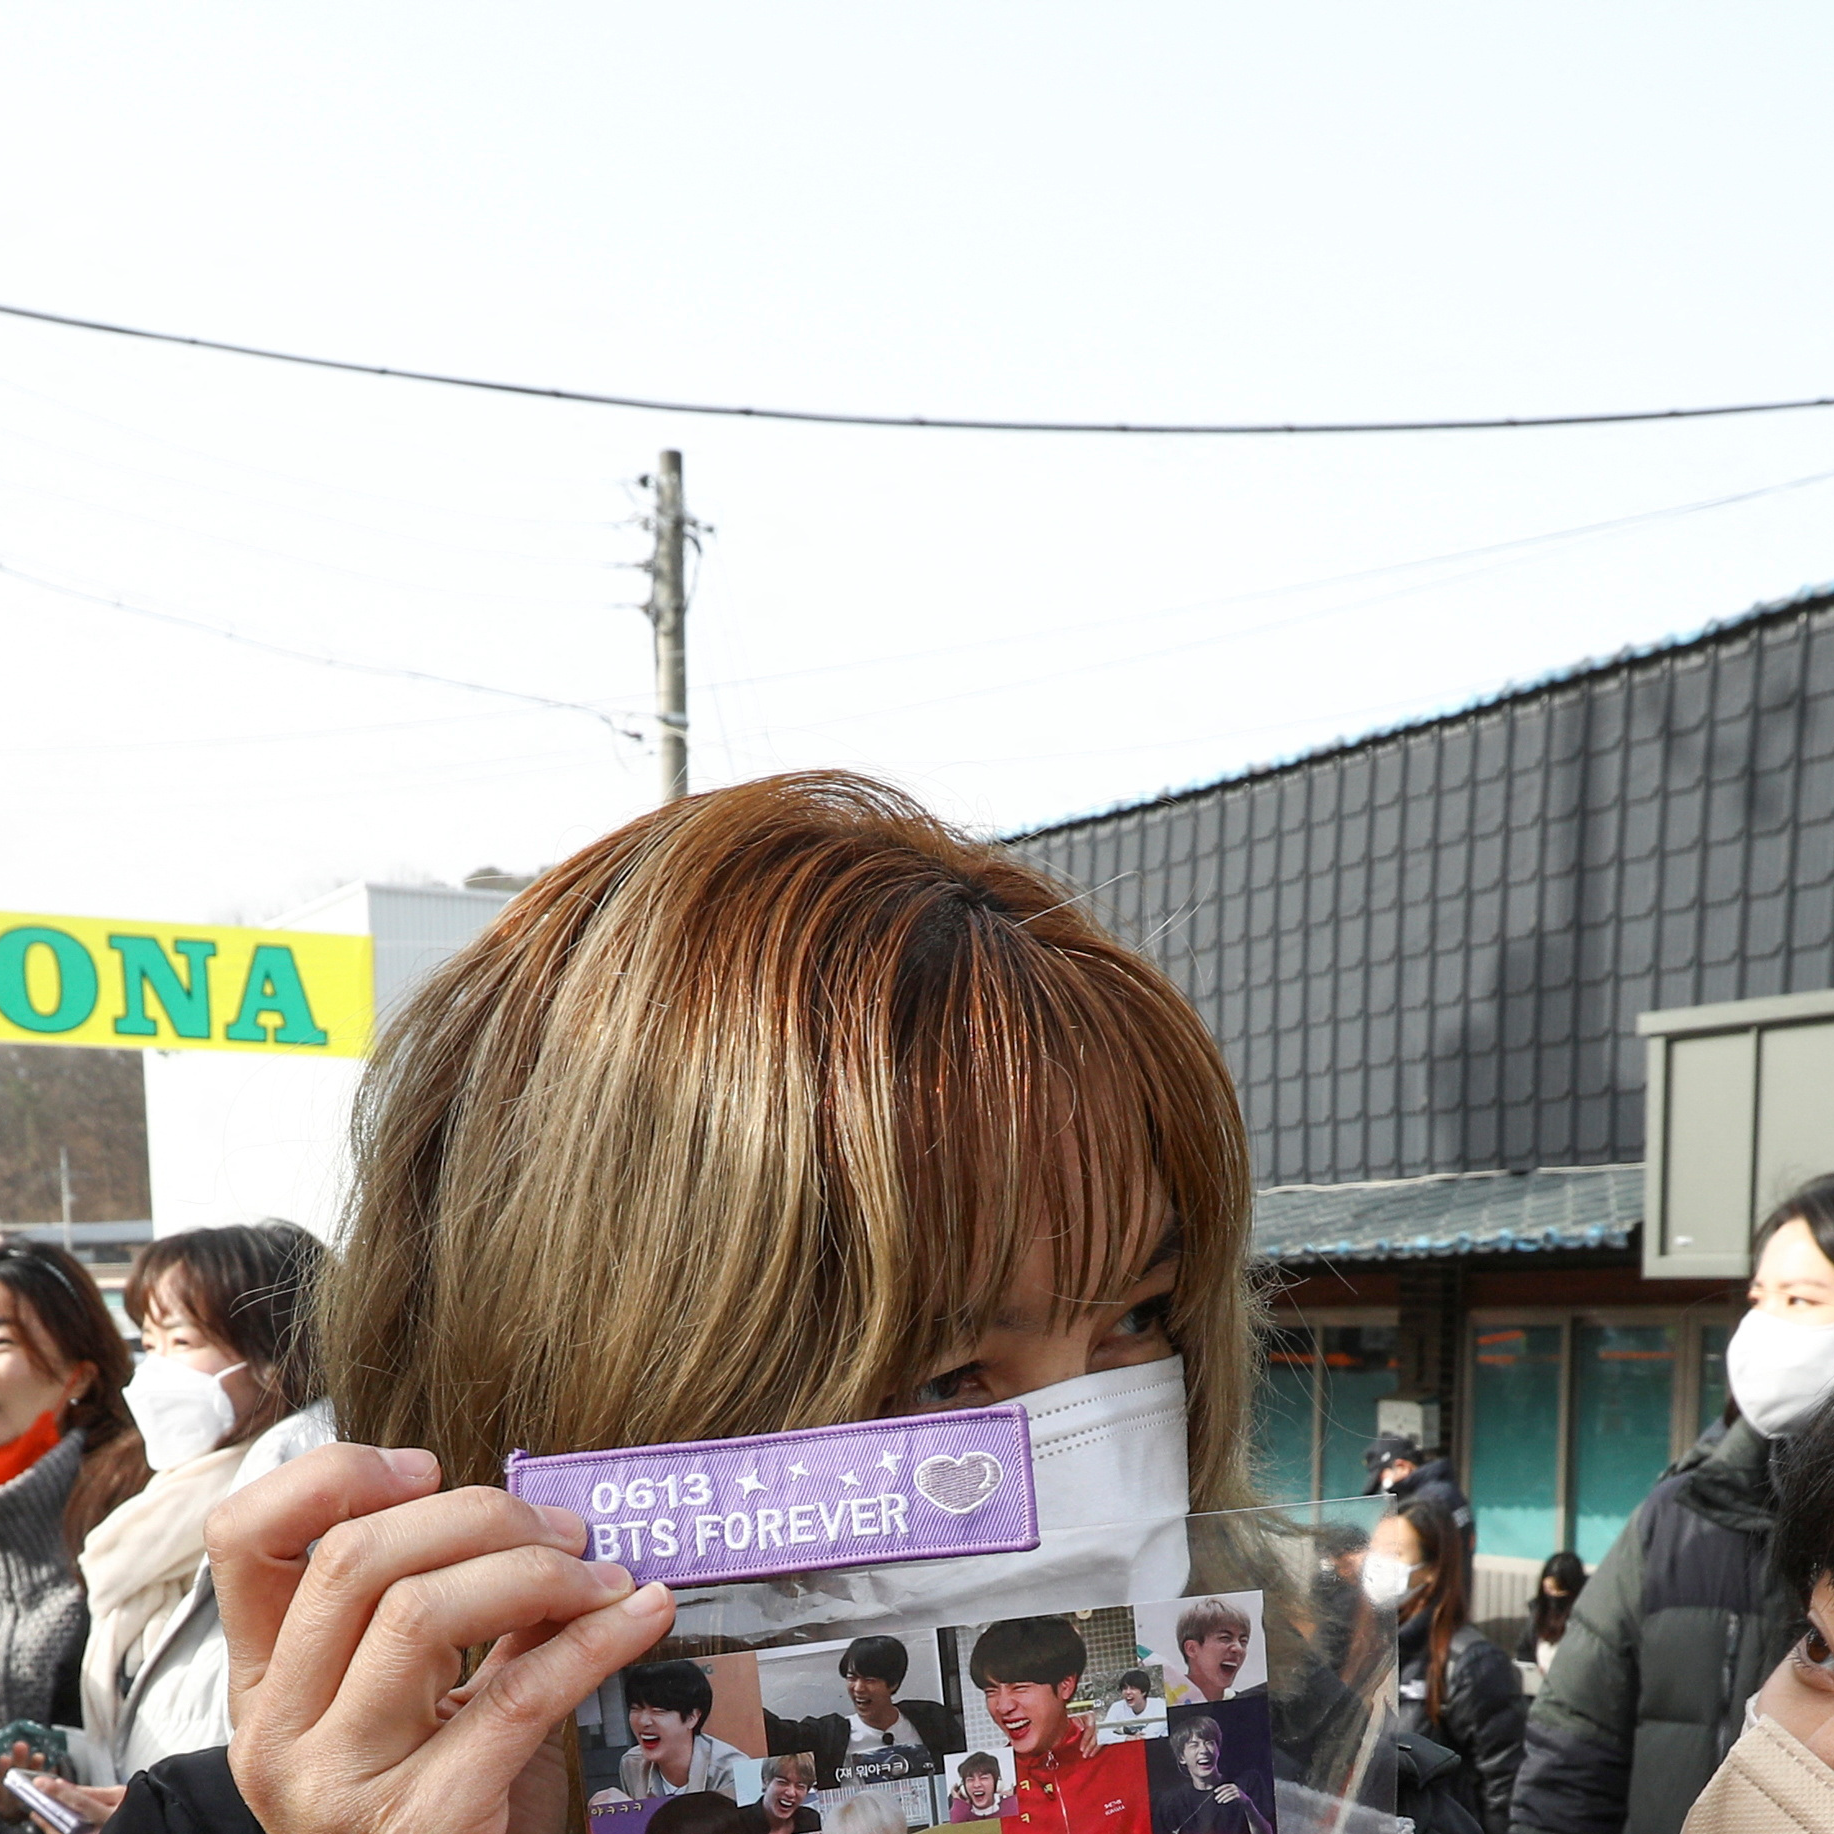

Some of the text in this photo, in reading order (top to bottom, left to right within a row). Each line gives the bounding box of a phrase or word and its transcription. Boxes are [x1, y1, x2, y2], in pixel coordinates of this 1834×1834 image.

[591, 1473, 714, 1514] 0613
[592, 1493, 911, 1563] BTS FOREVER
